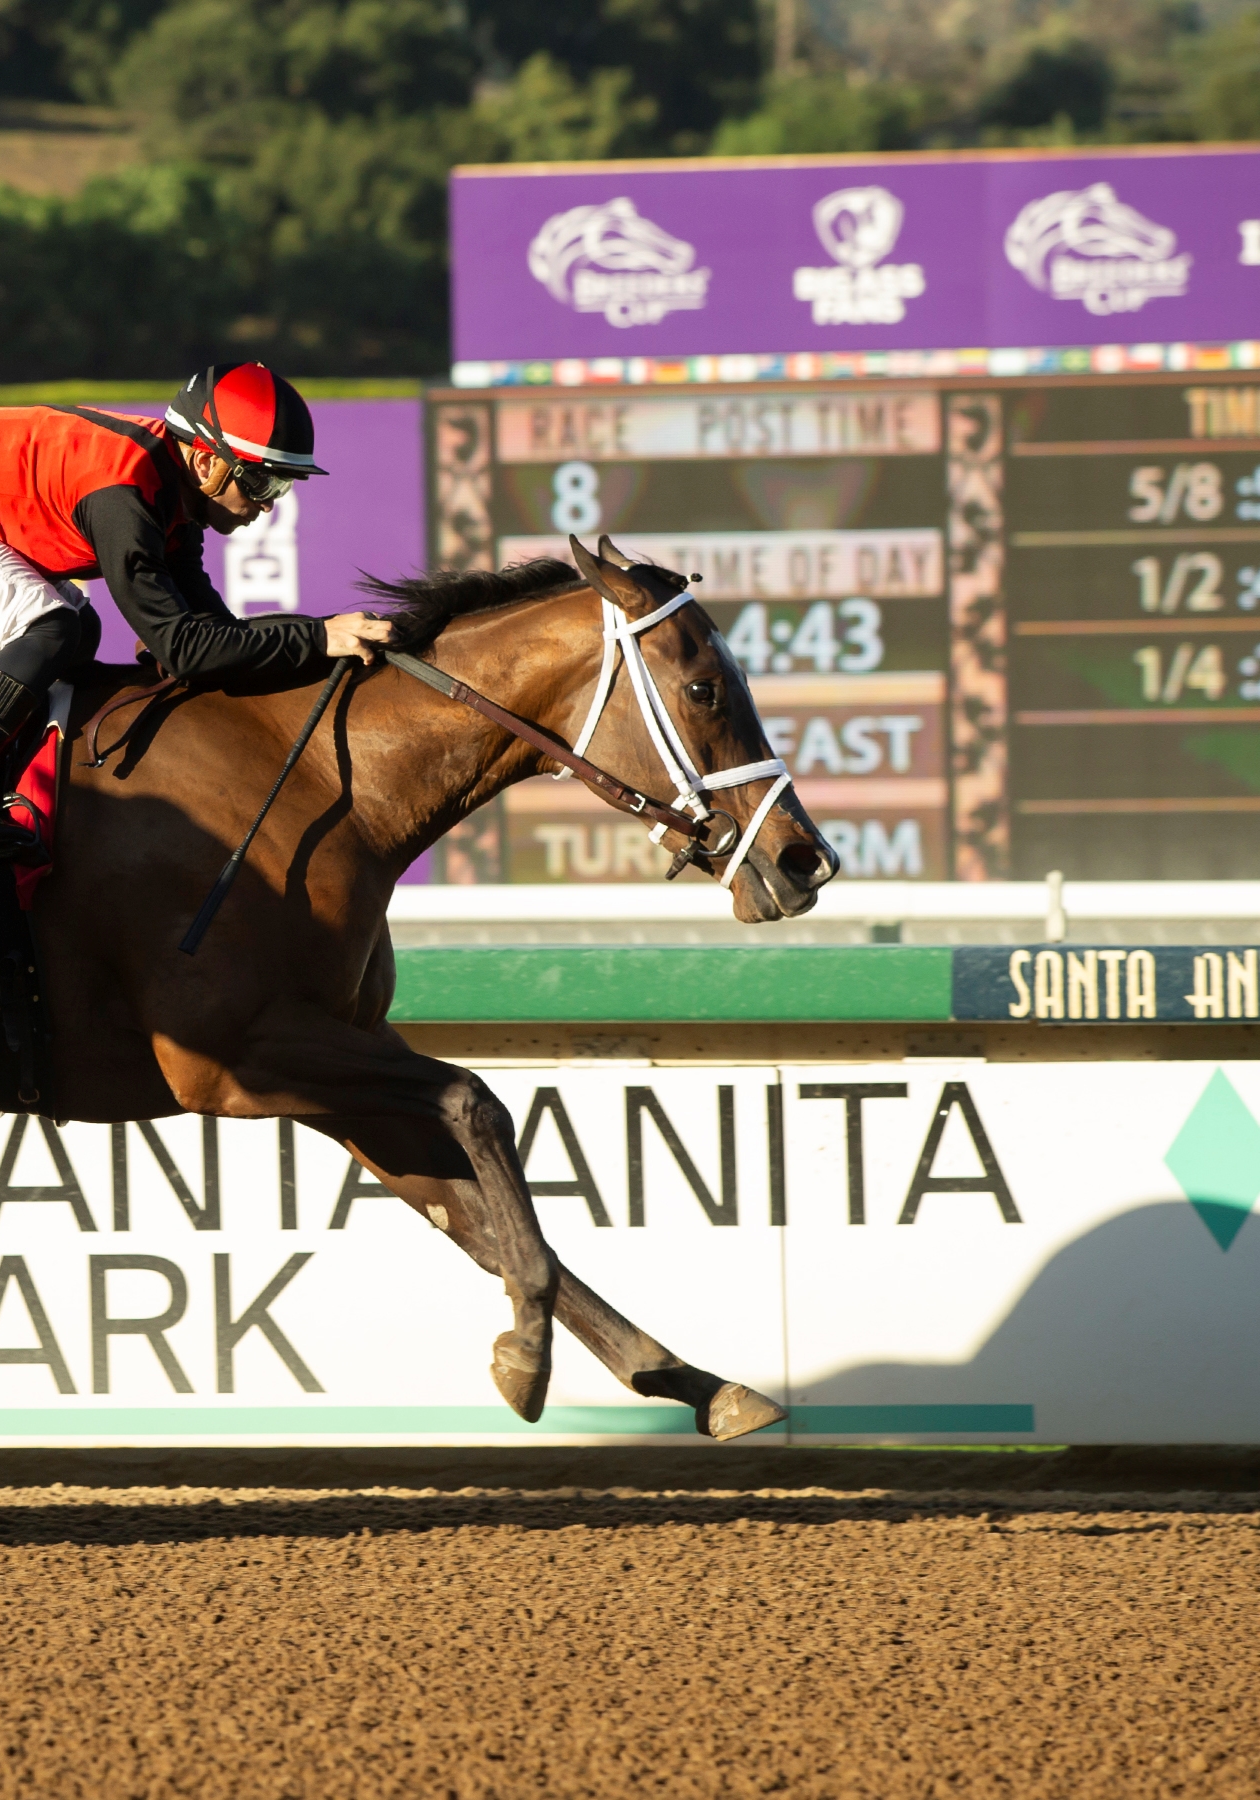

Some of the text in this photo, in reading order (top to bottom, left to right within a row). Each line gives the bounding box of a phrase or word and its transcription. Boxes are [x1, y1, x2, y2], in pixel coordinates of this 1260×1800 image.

[529, 399, 913, 452] RACE POST TIME
[551, 460, 602, 535] 8
[1129, 462, 1222, 525] 5/8
[671, 543, 933, 596] TIME OF DAY
[1132, 552, 1224, 614] 1/2
[728, 597, 884, 674] 4:43
[1133, 642, 1227, 703] 1/4
[764, 715, 923, 775] FAST
[534, 823, 674, 878] TUR
[1008, 949, 1260, 1019] SANTA AN
[515, 1081, 1025, 1229] ANITA
